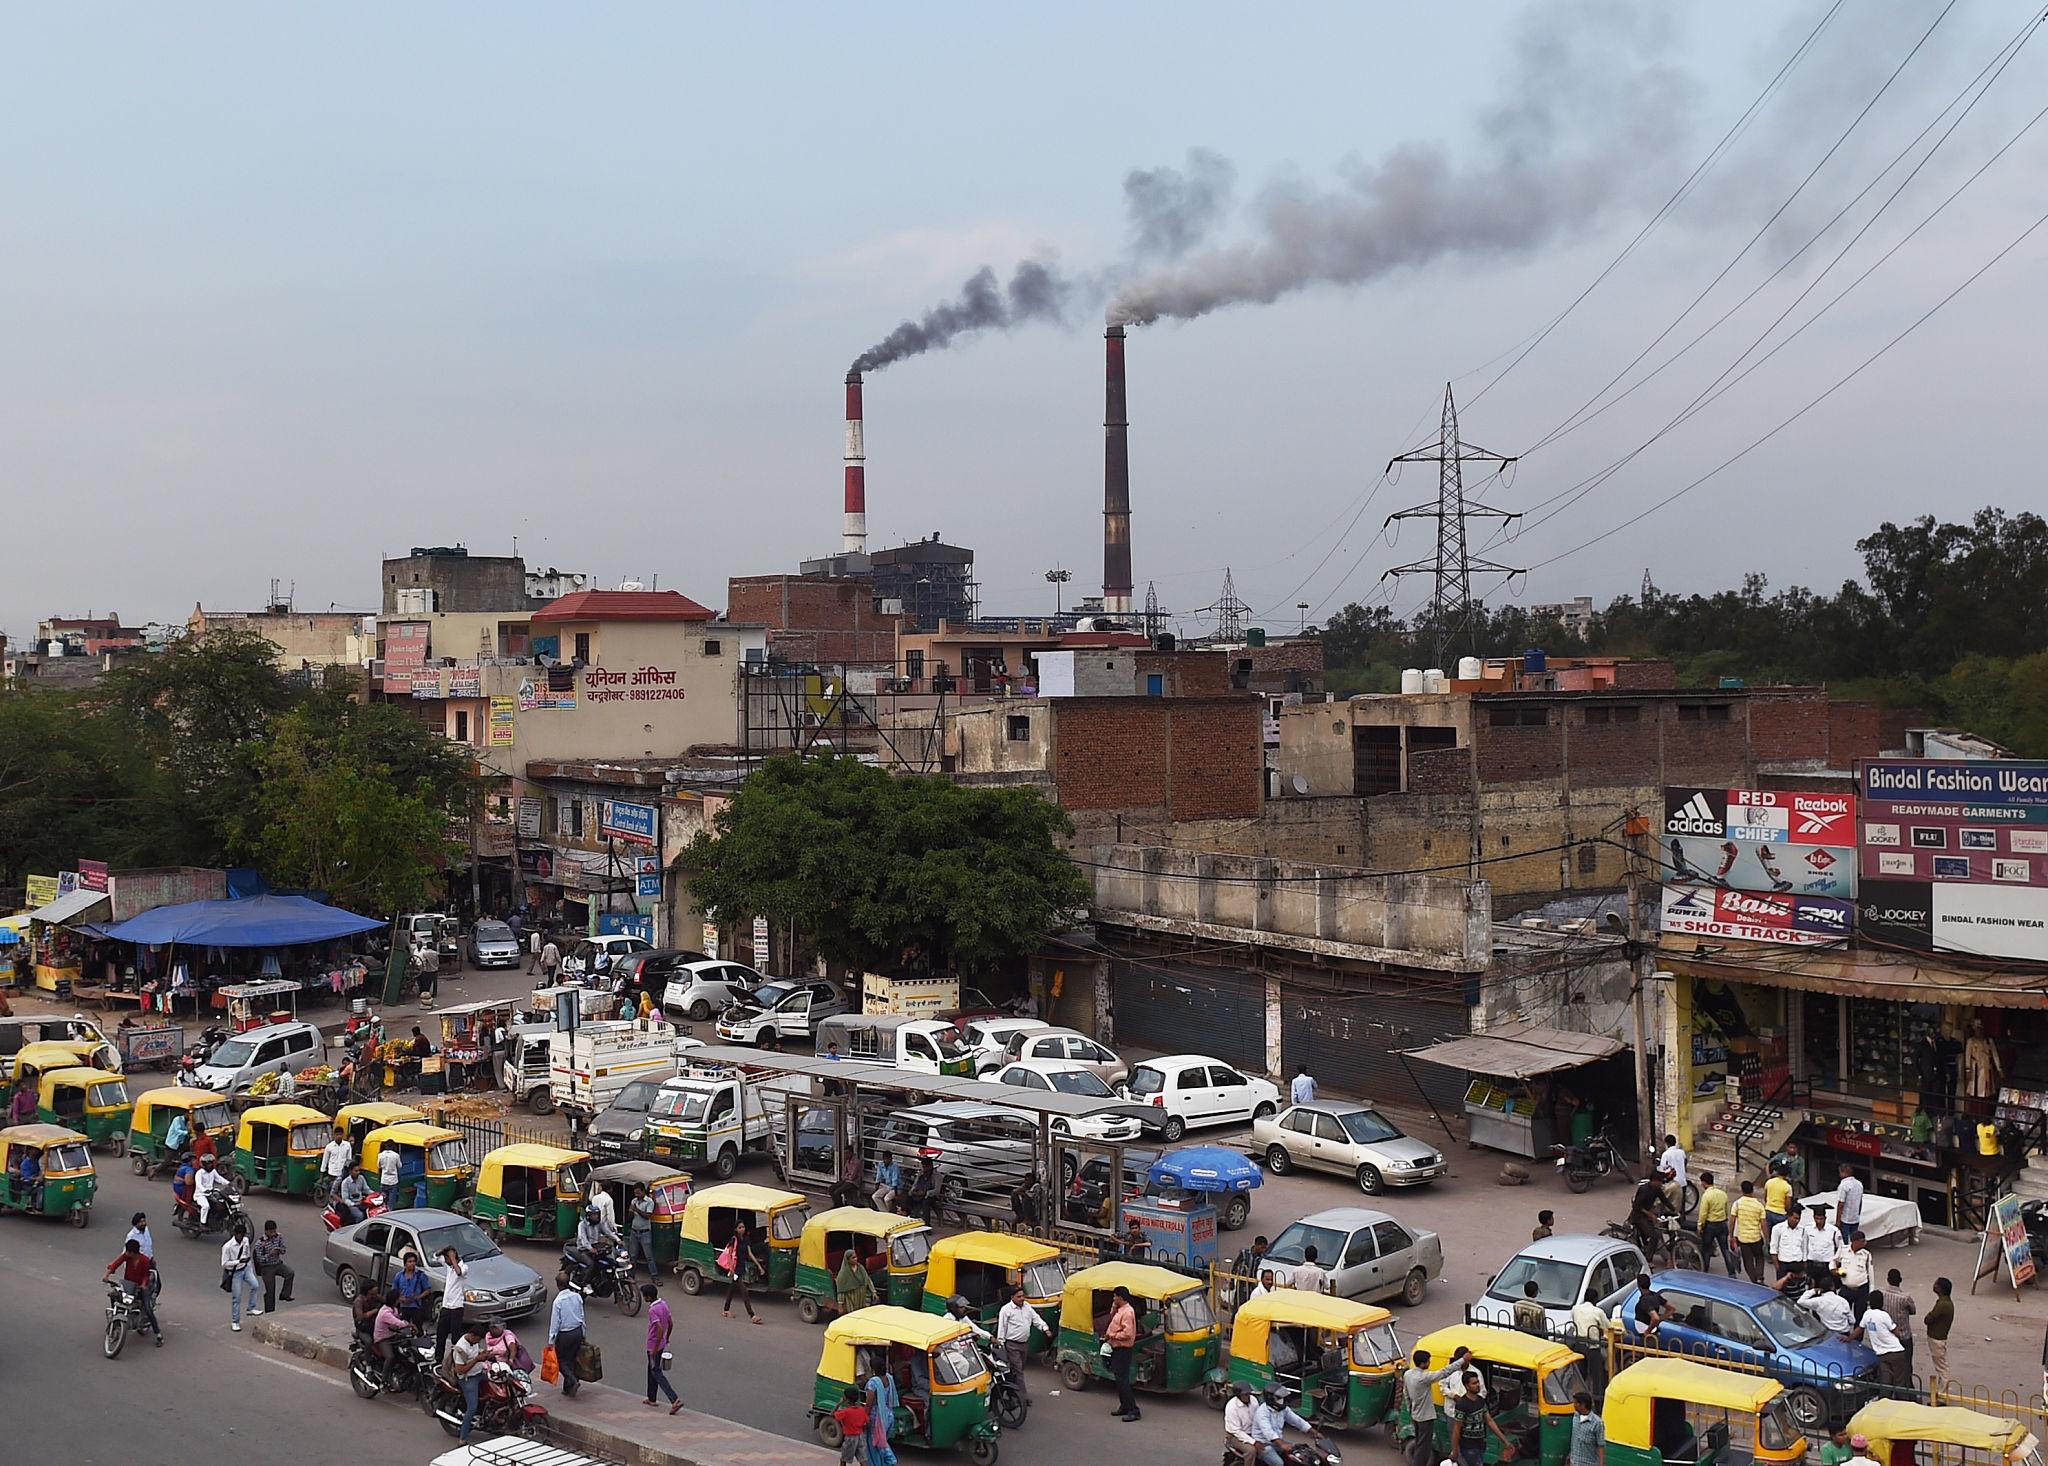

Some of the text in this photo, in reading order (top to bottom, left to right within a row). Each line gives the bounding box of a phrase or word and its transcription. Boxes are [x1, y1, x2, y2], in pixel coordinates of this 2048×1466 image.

[585, 666, 676, 688] यूनियन ऑफिस
[1870, 767, 2048, 792] Bindal Fashion Wear
[1738, 791, 1777, 806] RED
[1794, 797, 1849, 812] Reebok
[1892, 805, 2027, 819] READYMADE GARMENTS
[1667, 817, 1723, 835] adidas
[1735, 827, 1780, 841] CHIEF
[1868, 836, 1897, 844] JOCKEY
[2004, 866, 2024, 876] FOG
[640, 880, 659, 889] ATM
[1720, 891, 1792, 917] Bata
[1666, 908, 1707, 918] POWER
[1880, 909, 1926, 921] JOCKEY
[1941, 915, 2044, 929] BINDAL FASHION WEAR
[1684, 920, 1732, 935] SHOE
[1739, 926, 1801, 943] TRACK
[1834, 1134, 1872, 1149] Campus
